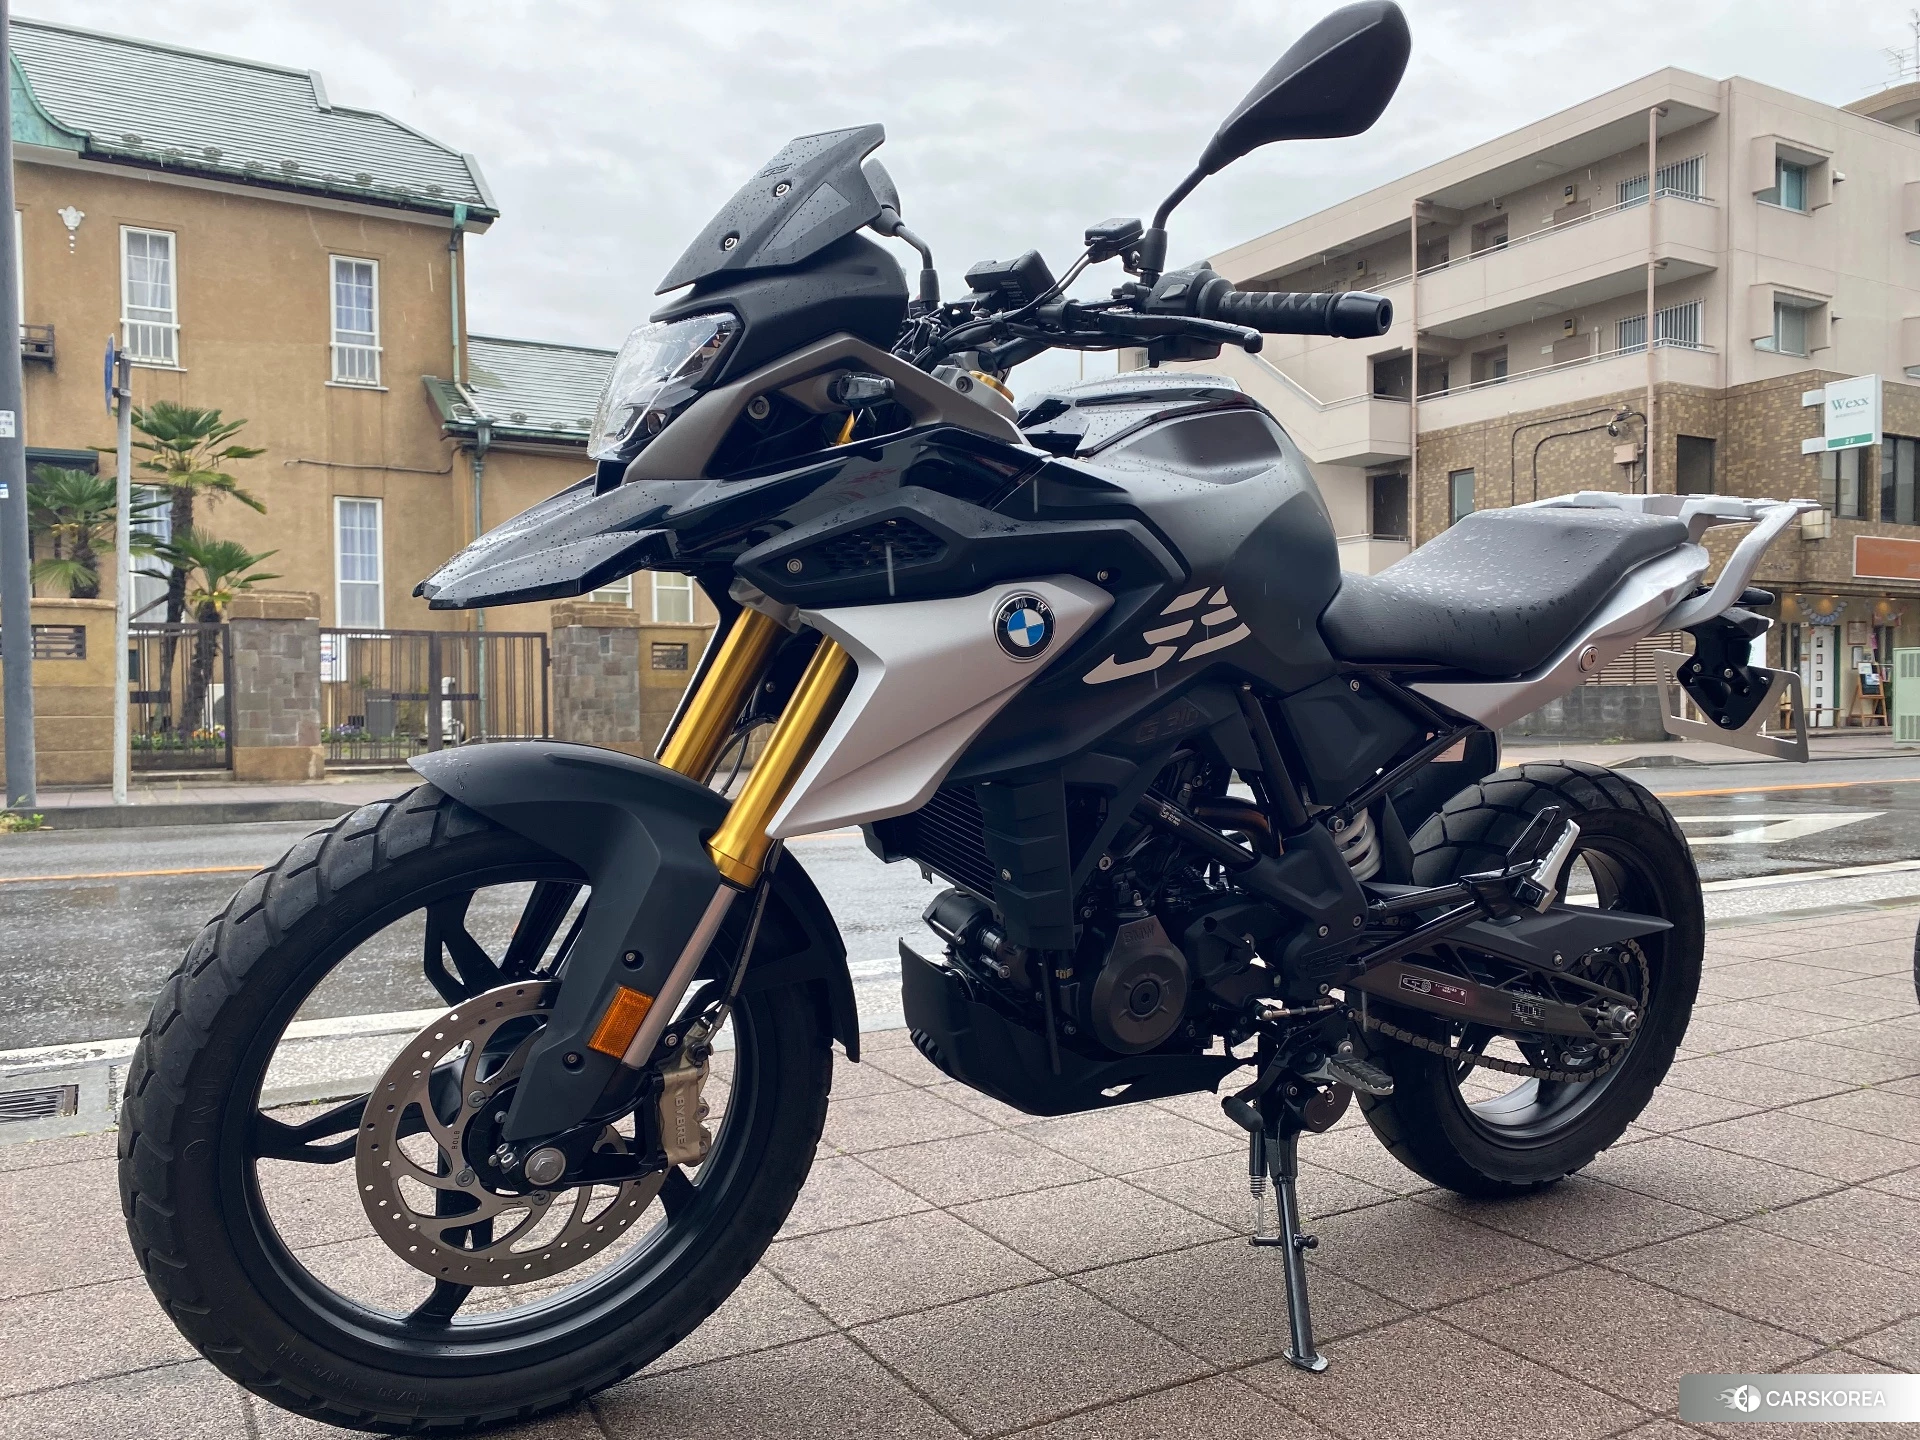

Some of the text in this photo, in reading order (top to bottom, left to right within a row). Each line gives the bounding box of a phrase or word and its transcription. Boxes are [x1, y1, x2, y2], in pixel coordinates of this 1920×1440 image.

[1831, 397, 1870, 411] Wexx
[999, 597, 1048, 623] BMW
[1082, 586, 1252, 685] GS
[1123, 924, 1155, 943] BMW
[674, 1097, 687, 1145] BYBRE
